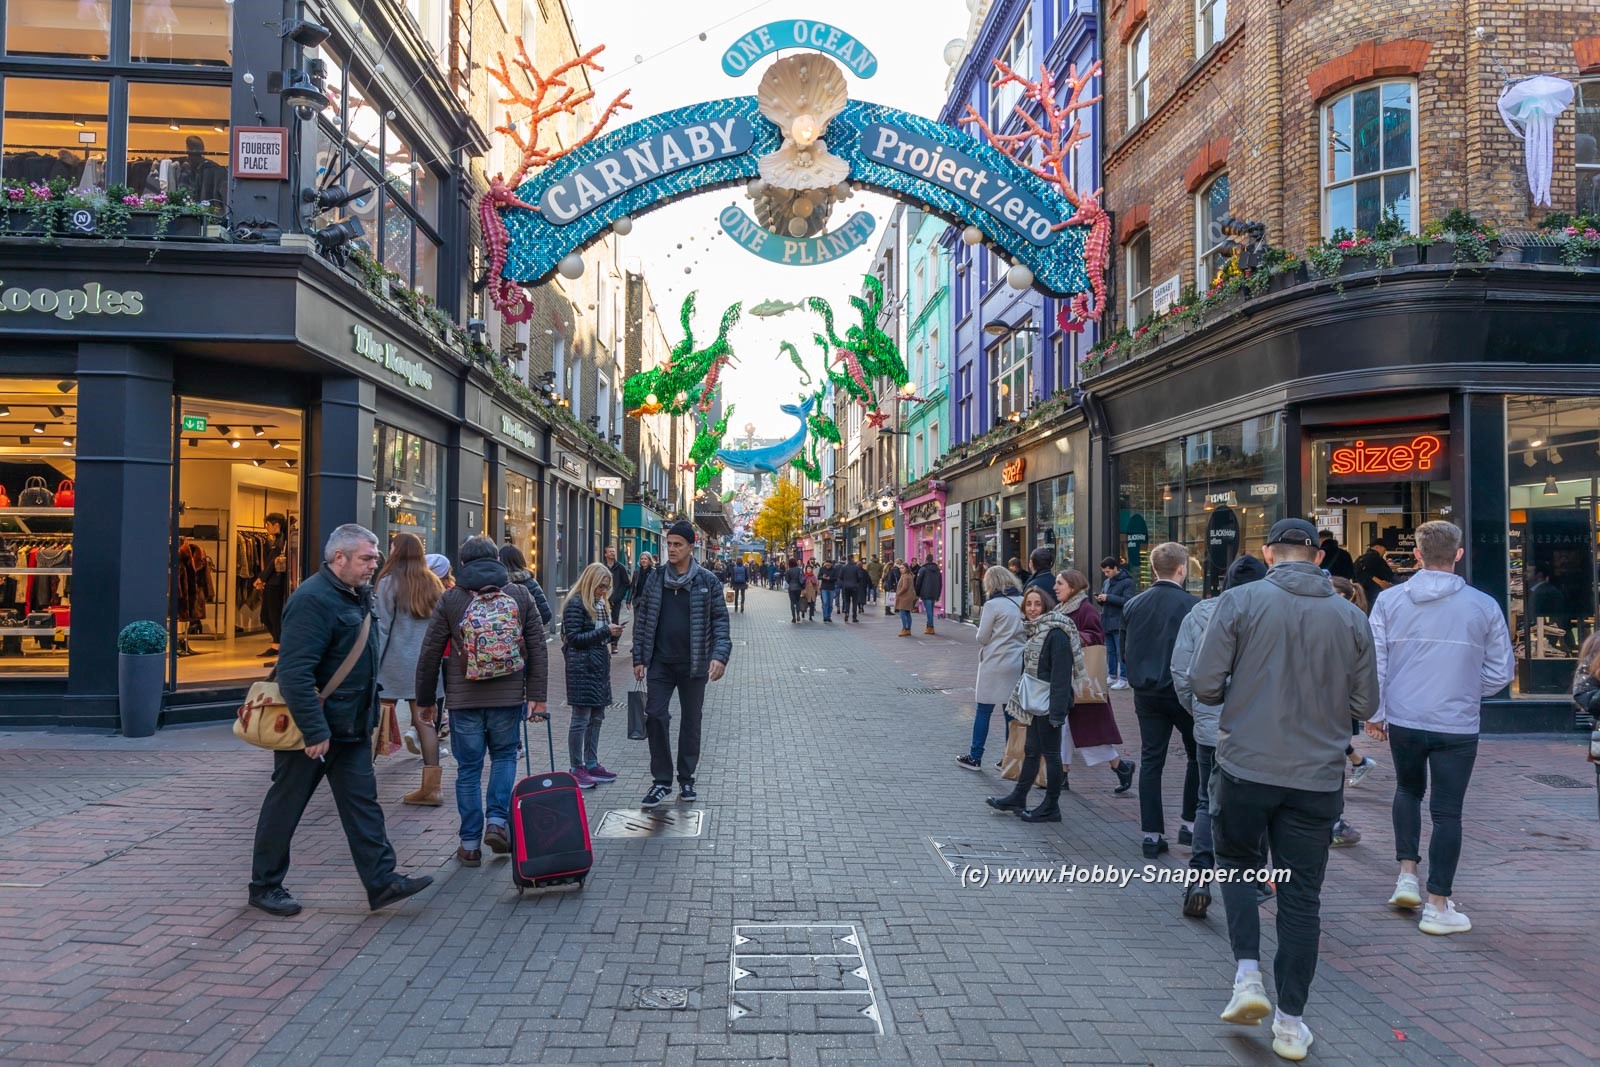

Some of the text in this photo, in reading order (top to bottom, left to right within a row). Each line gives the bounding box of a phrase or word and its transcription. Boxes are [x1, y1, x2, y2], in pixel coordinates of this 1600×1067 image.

[726, 20, 875, 74] ONE OCEAN
[243, 156, 269, 170] PLACE
[547, 117, 737, 220] CARNABY
[872, 126, 1051, 241] Project Zero
[721, 206, 874, 265] ONE PLANET
[0, 282, 144, 320] ooples
[1155, 281, 1174, 299] CARNABY
[1155, 293, 1169, 309] STREET
[354, 324, 433, 391] The Kooples
[1001, 457, 1025, 486] size?
[1331, 435, 1440, 474] size?
